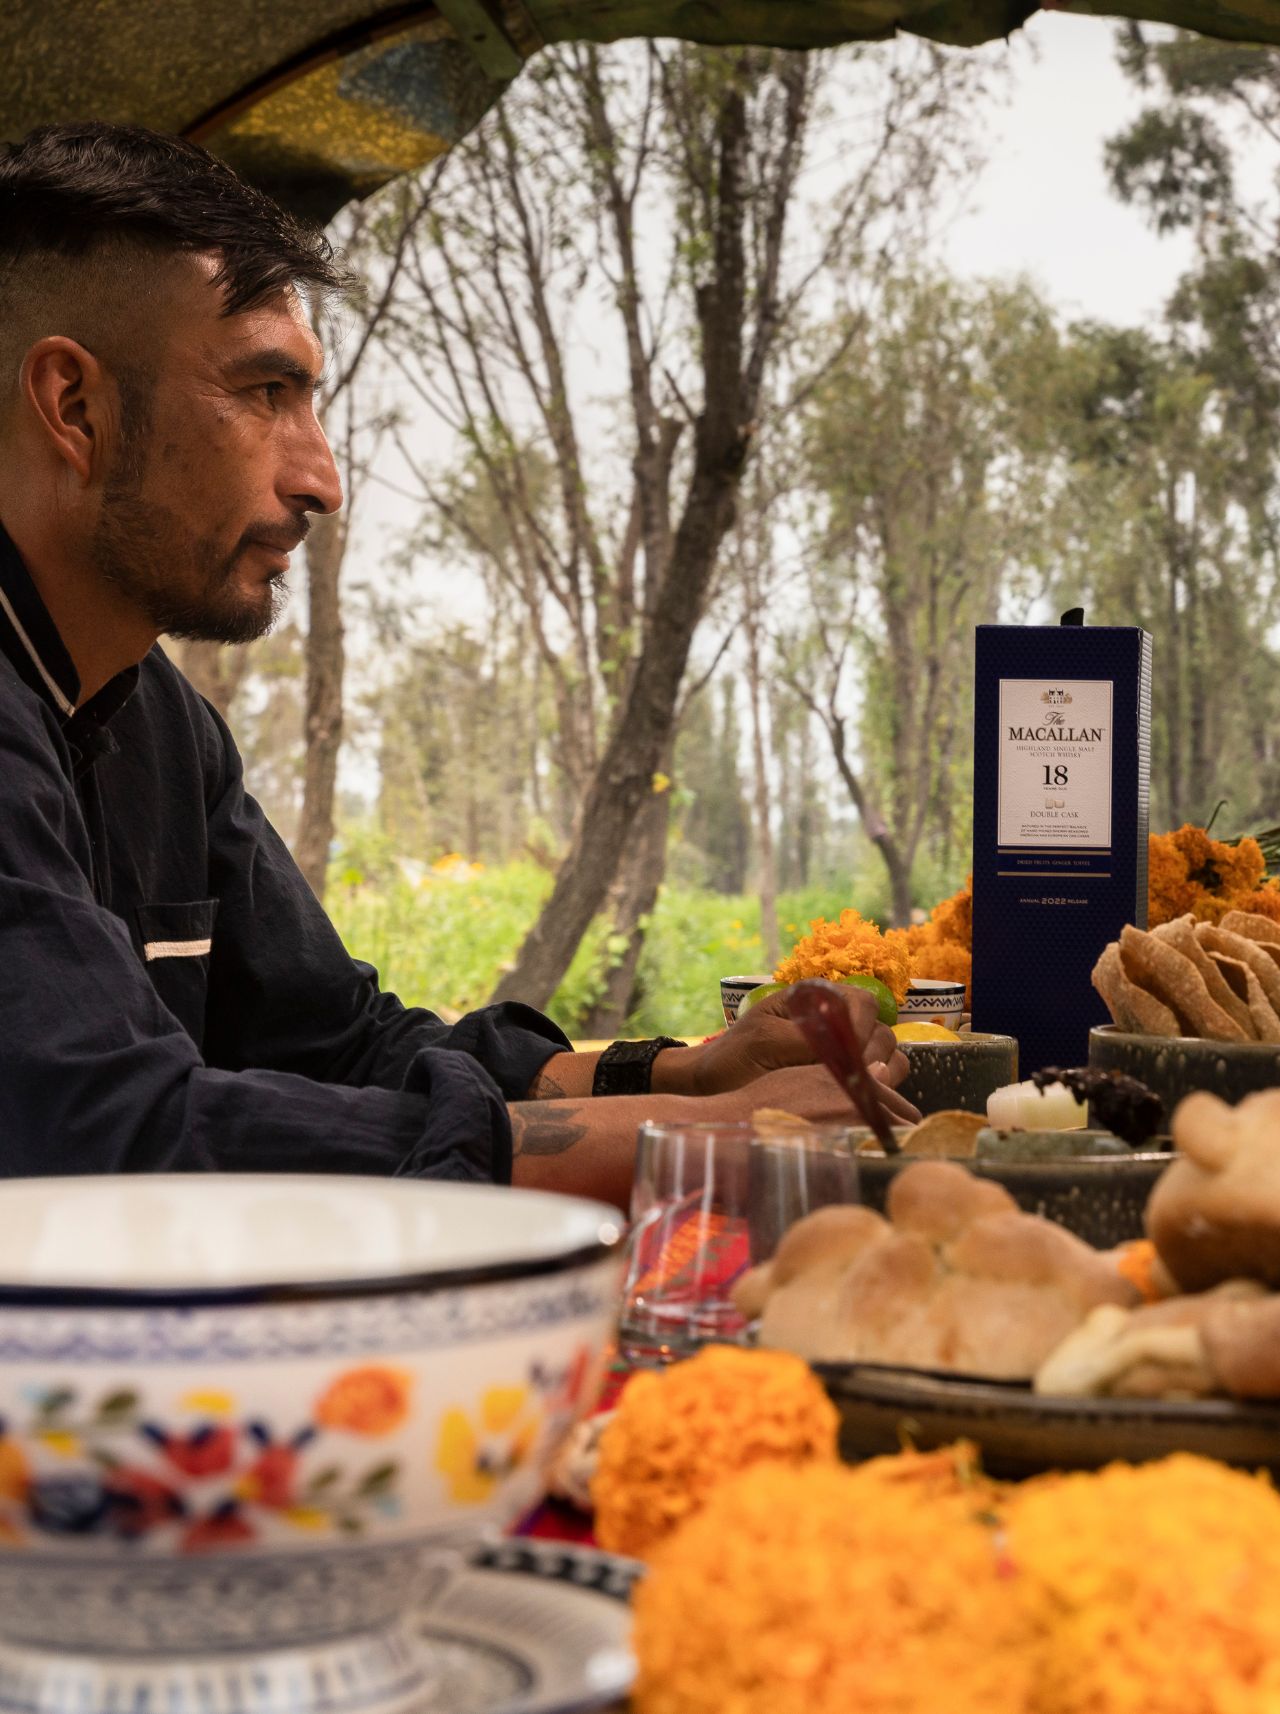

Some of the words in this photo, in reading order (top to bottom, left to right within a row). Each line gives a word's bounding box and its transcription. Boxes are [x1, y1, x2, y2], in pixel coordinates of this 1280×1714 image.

[1043, 711, 1066, 726] The
[1008, 727, 1102, 742] MACALLAN
[1042, 764, 1069, 786] 18
[1030, 810, 1058, 818] DOUBLE
[1041, 897, 1066, 905] 2022
